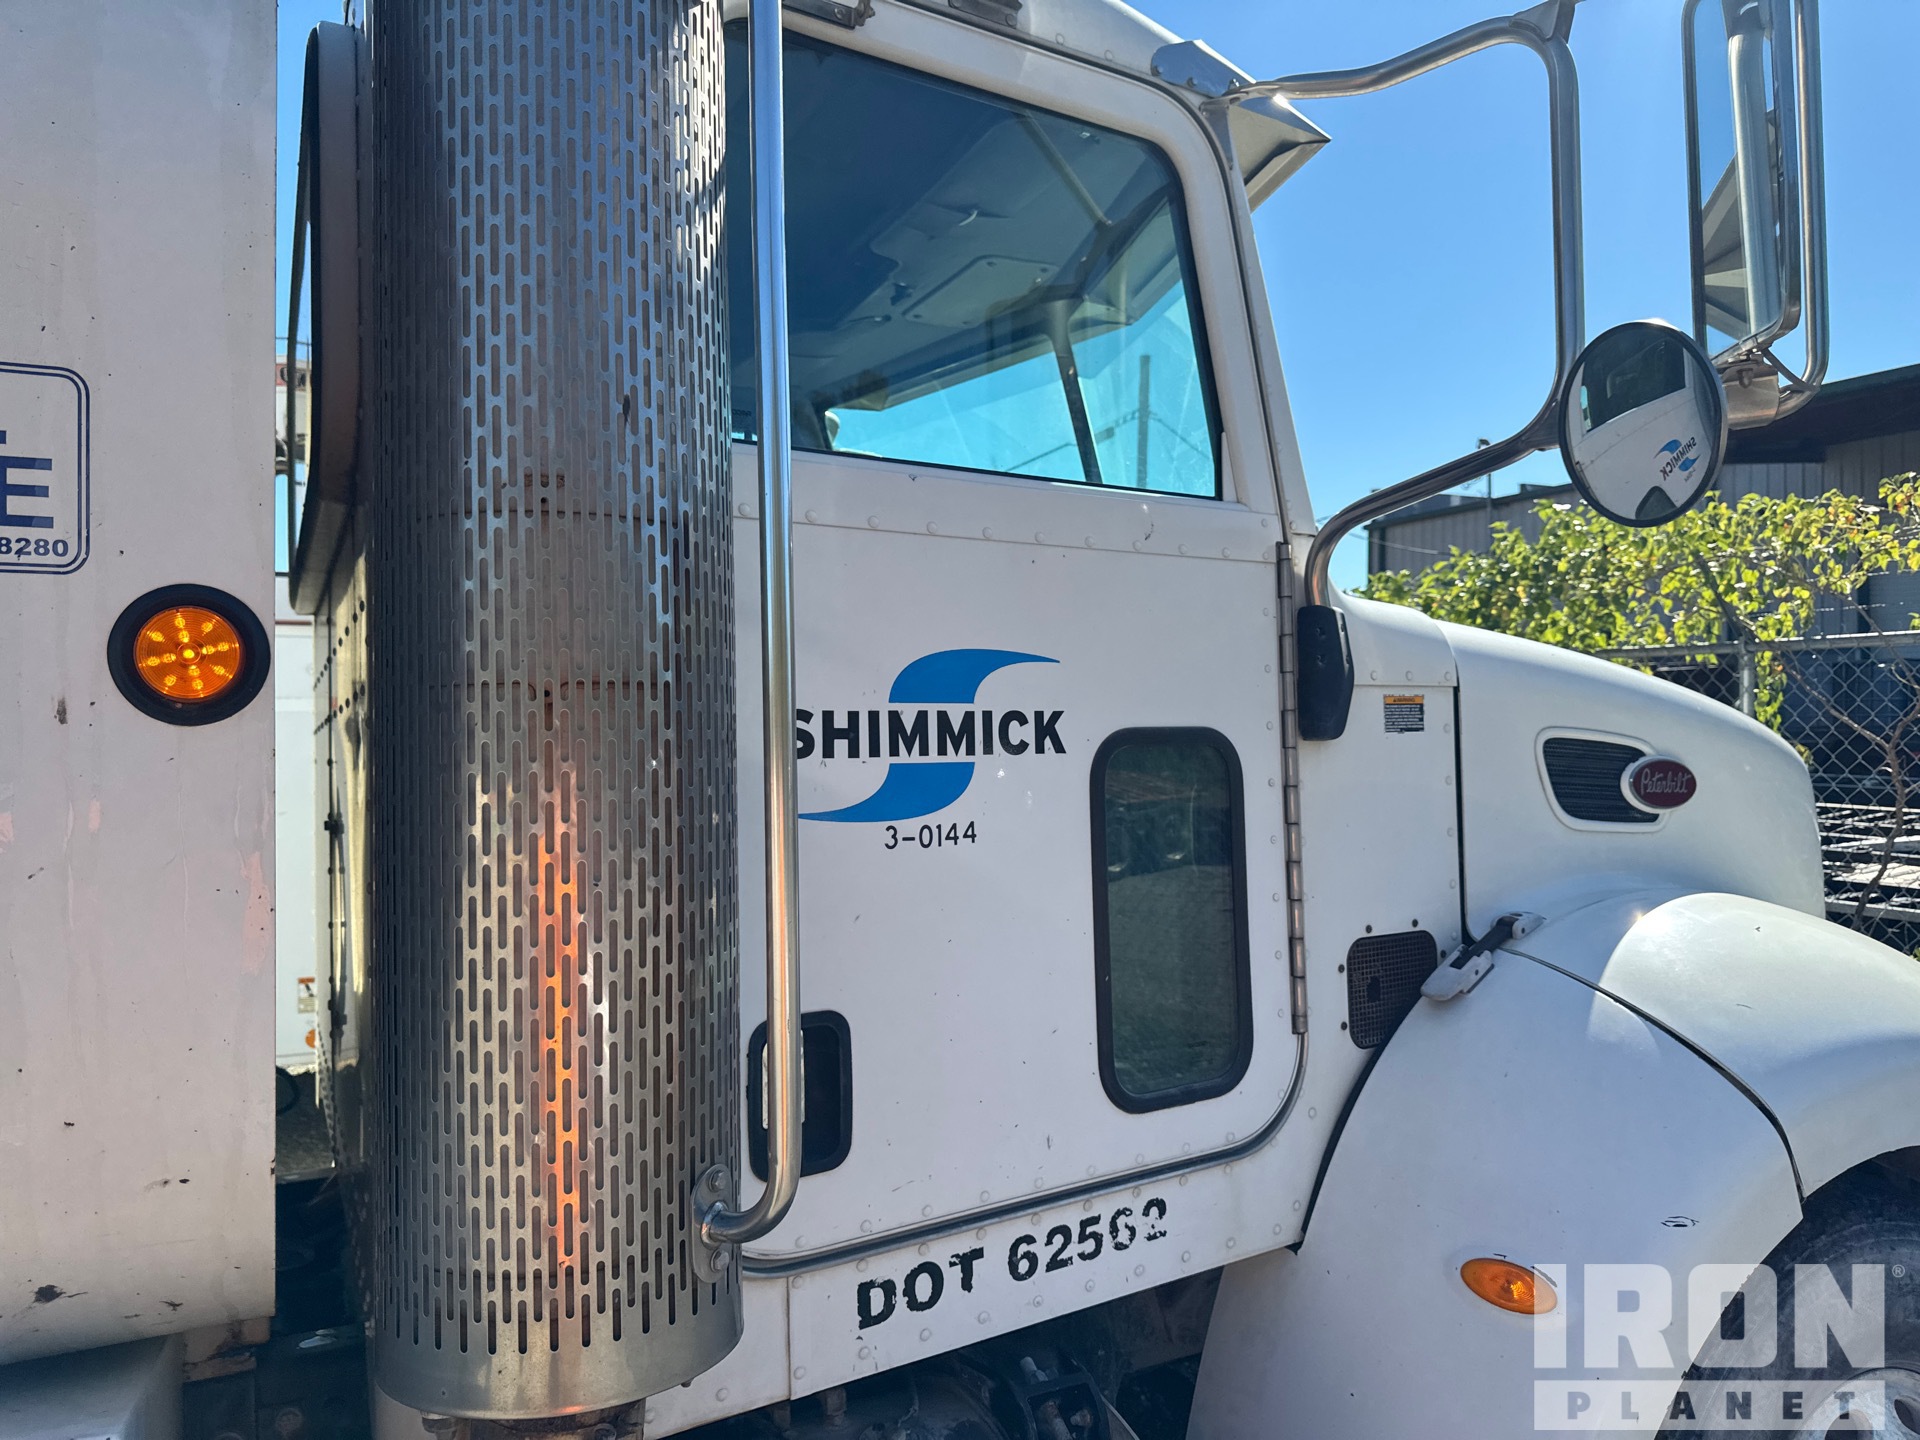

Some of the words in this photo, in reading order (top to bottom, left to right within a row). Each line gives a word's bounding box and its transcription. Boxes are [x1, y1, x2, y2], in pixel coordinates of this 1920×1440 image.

[1640, 767, 1692, 796] Peterbilt
[884, 821, 977, 850] 3-0144
[857, 1246, 984, 1330] DOT
